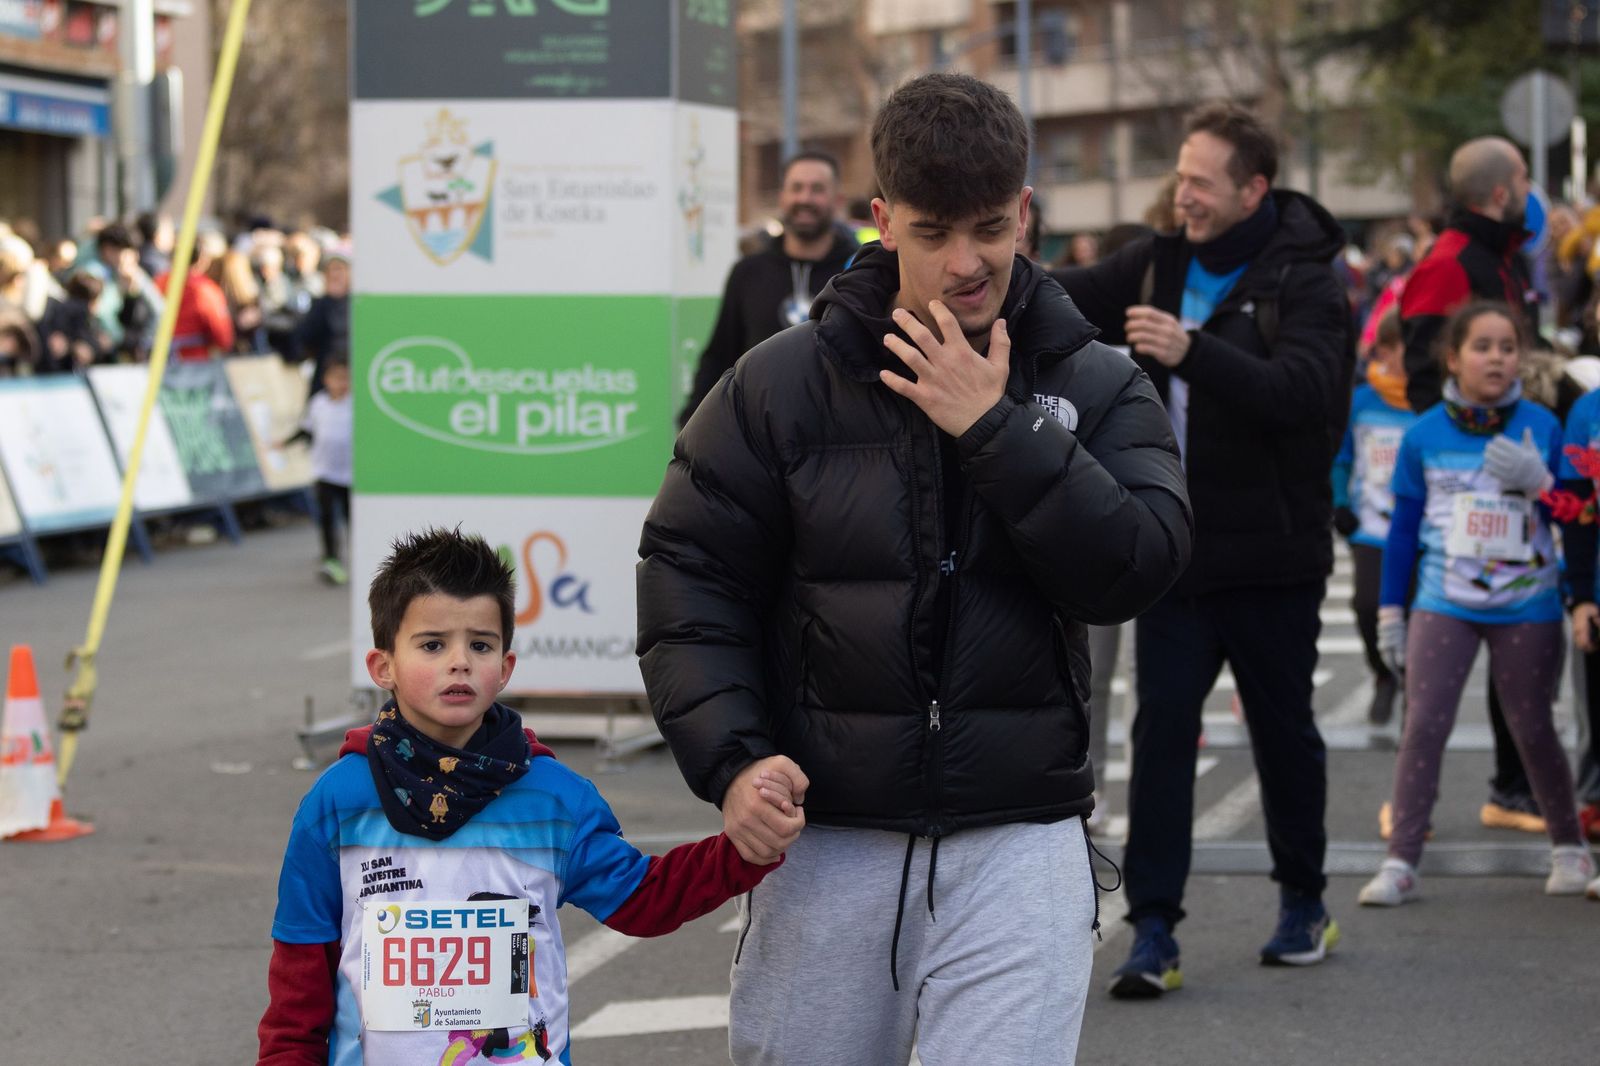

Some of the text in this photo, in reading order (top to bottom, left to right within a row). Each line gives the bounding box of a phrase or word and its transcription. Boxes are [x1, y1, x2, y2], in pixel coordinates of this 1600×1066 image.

[381, 358, 637, 395] autoescuelas
[1033, 393, 1058, 407] THE
[449, 394, 638, 448] el pilar
[1466, 511, 1508, 538] 6911
[371, 856, 392, 869] SAN
[362, 867, 406, 885] ILVESTRE
[404, 908, 515, 930] SETEL
[383, 936, 491, 987] 6629
[418, 987, 455, 998] PABLO
[434, 1008, 482, 1018] Ayuntamiento
[434, 1018, 482, 1026] de Salamanca
